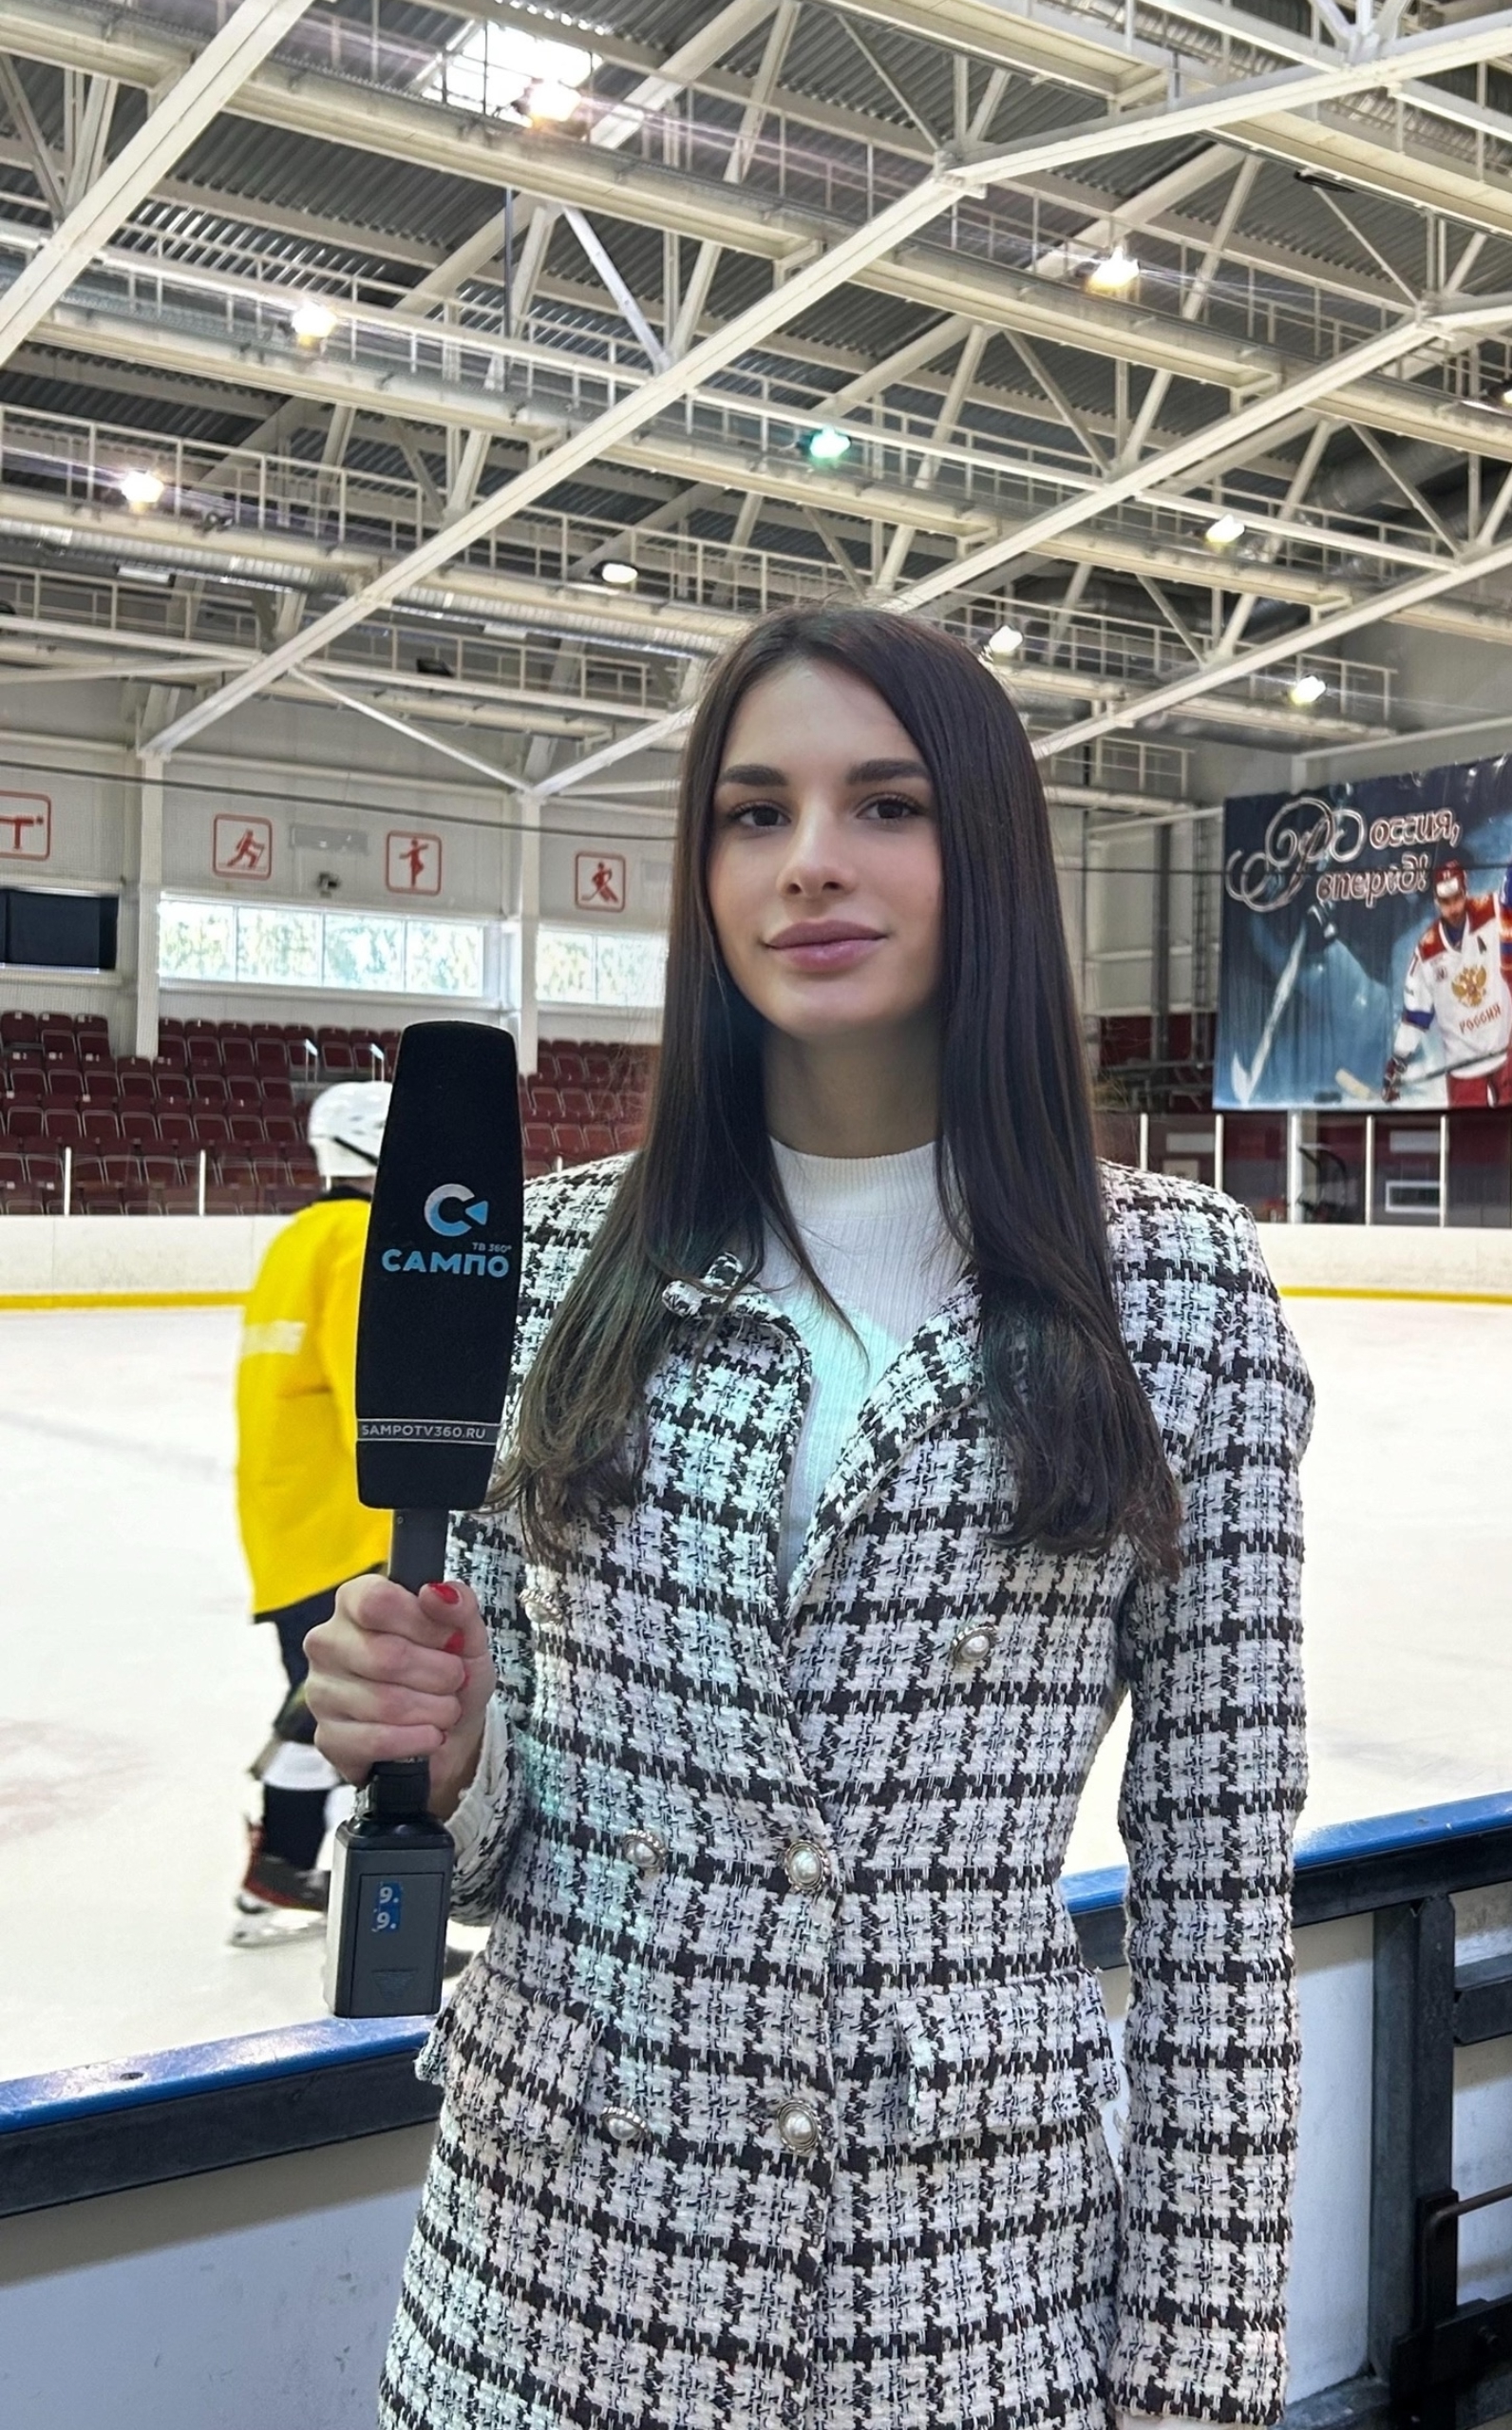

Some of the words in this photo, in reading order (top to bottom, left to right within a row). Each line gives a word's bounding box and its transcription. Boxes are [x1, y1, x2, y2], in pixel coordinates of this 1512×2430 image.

[472, 1242, 486, 1251] ТВ
[382, 1248, 509, 1278] САМПО
[362, 1424, 486, 1439] SAMPOTV360.RU
